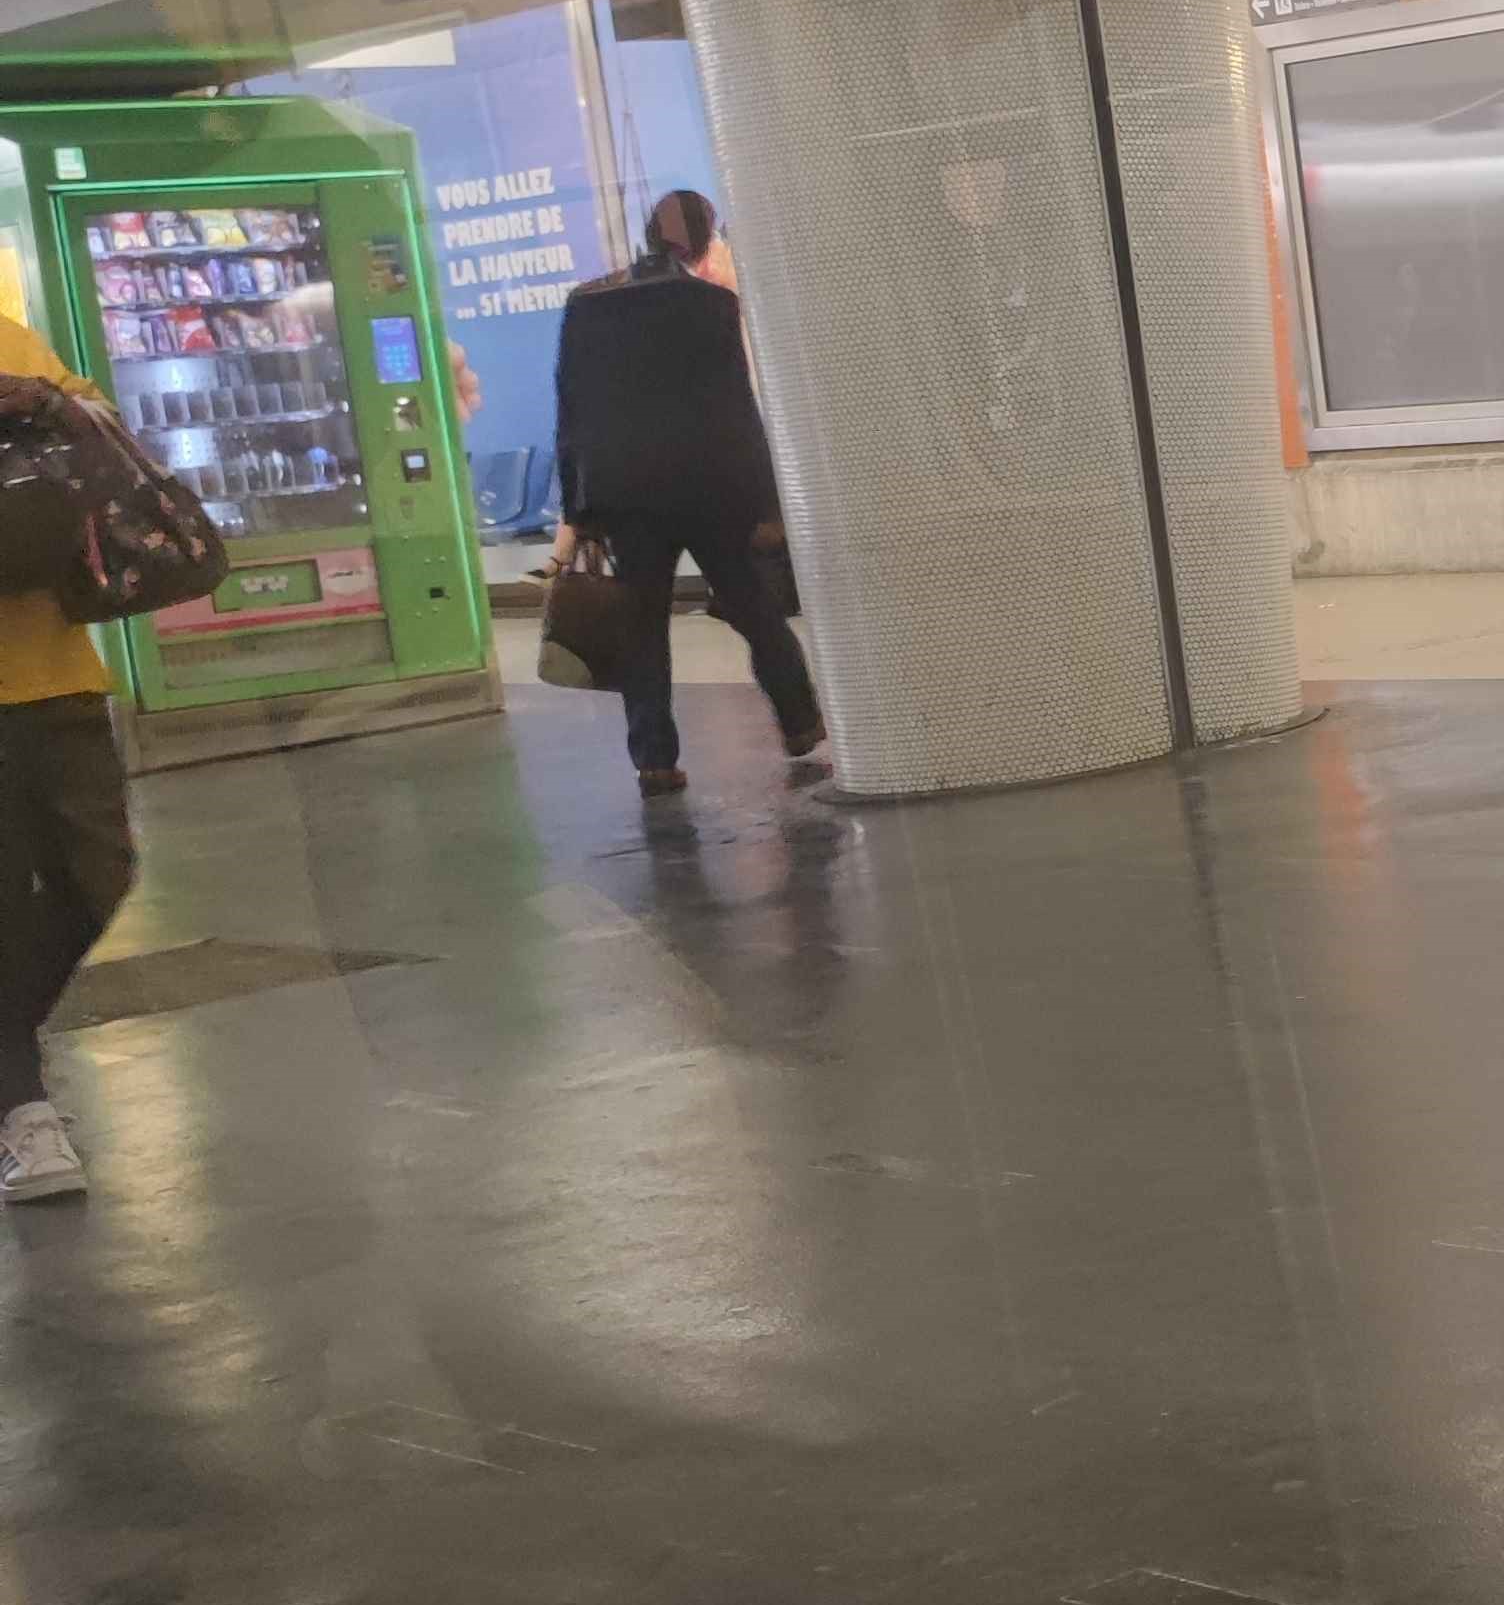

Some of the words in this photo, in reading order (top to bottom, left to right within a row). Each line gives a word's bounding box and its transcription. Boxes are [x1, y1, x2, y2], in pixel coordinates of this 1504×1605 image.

[436, 178, 490, 211] VOUS
[494, 168, 555, 202] ALLEZ
[444, 212, 534, 249] PRENDRE
[538, 204, 564, 234] DE
[449, 258, 478, 287] LA
[480, 244, 574, 283] HAUTEUR
